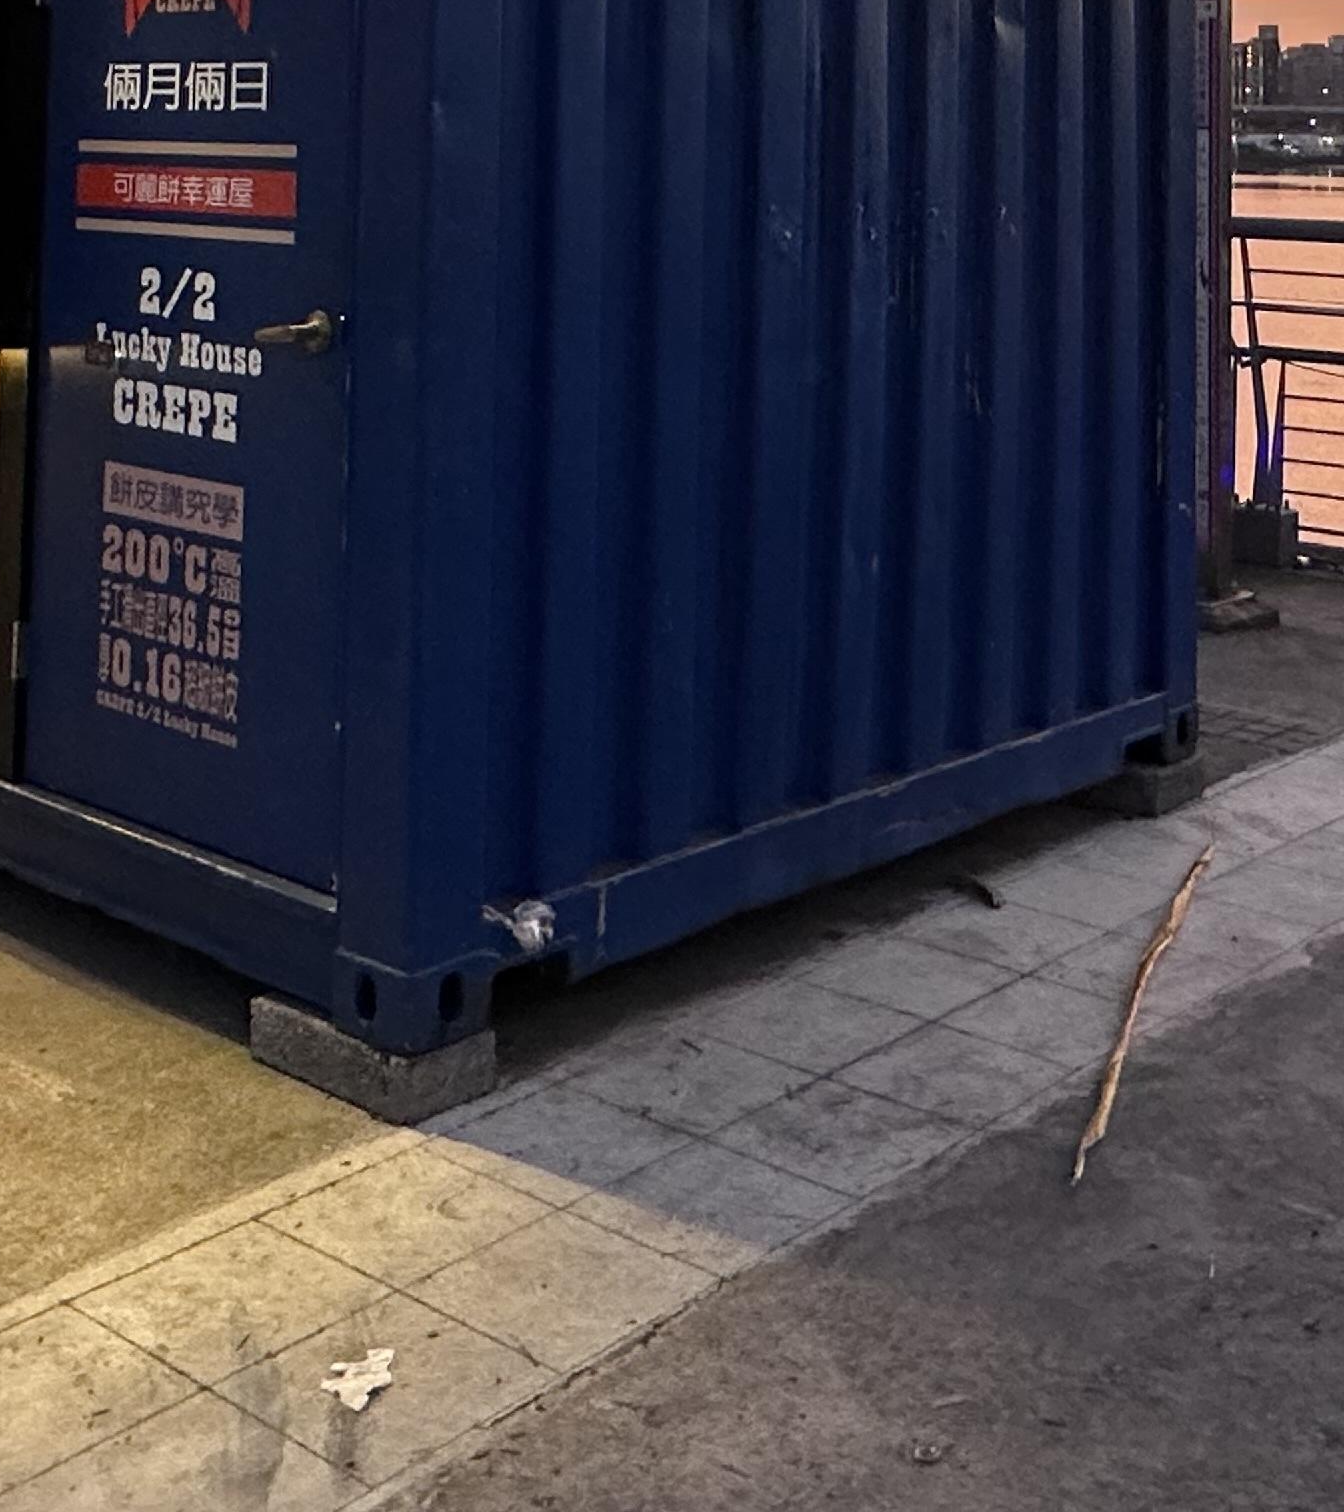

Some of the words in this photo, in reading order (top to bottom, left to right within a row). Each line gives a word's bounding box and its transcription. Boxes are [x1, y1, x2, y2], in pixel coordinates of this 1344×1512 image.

[103, 61, 269, 111] 倆月倆日
[140, 266, 215, 322] 2/2
[179, 332, 262, 376] House
[113, 377, 238, 443] CREPE
